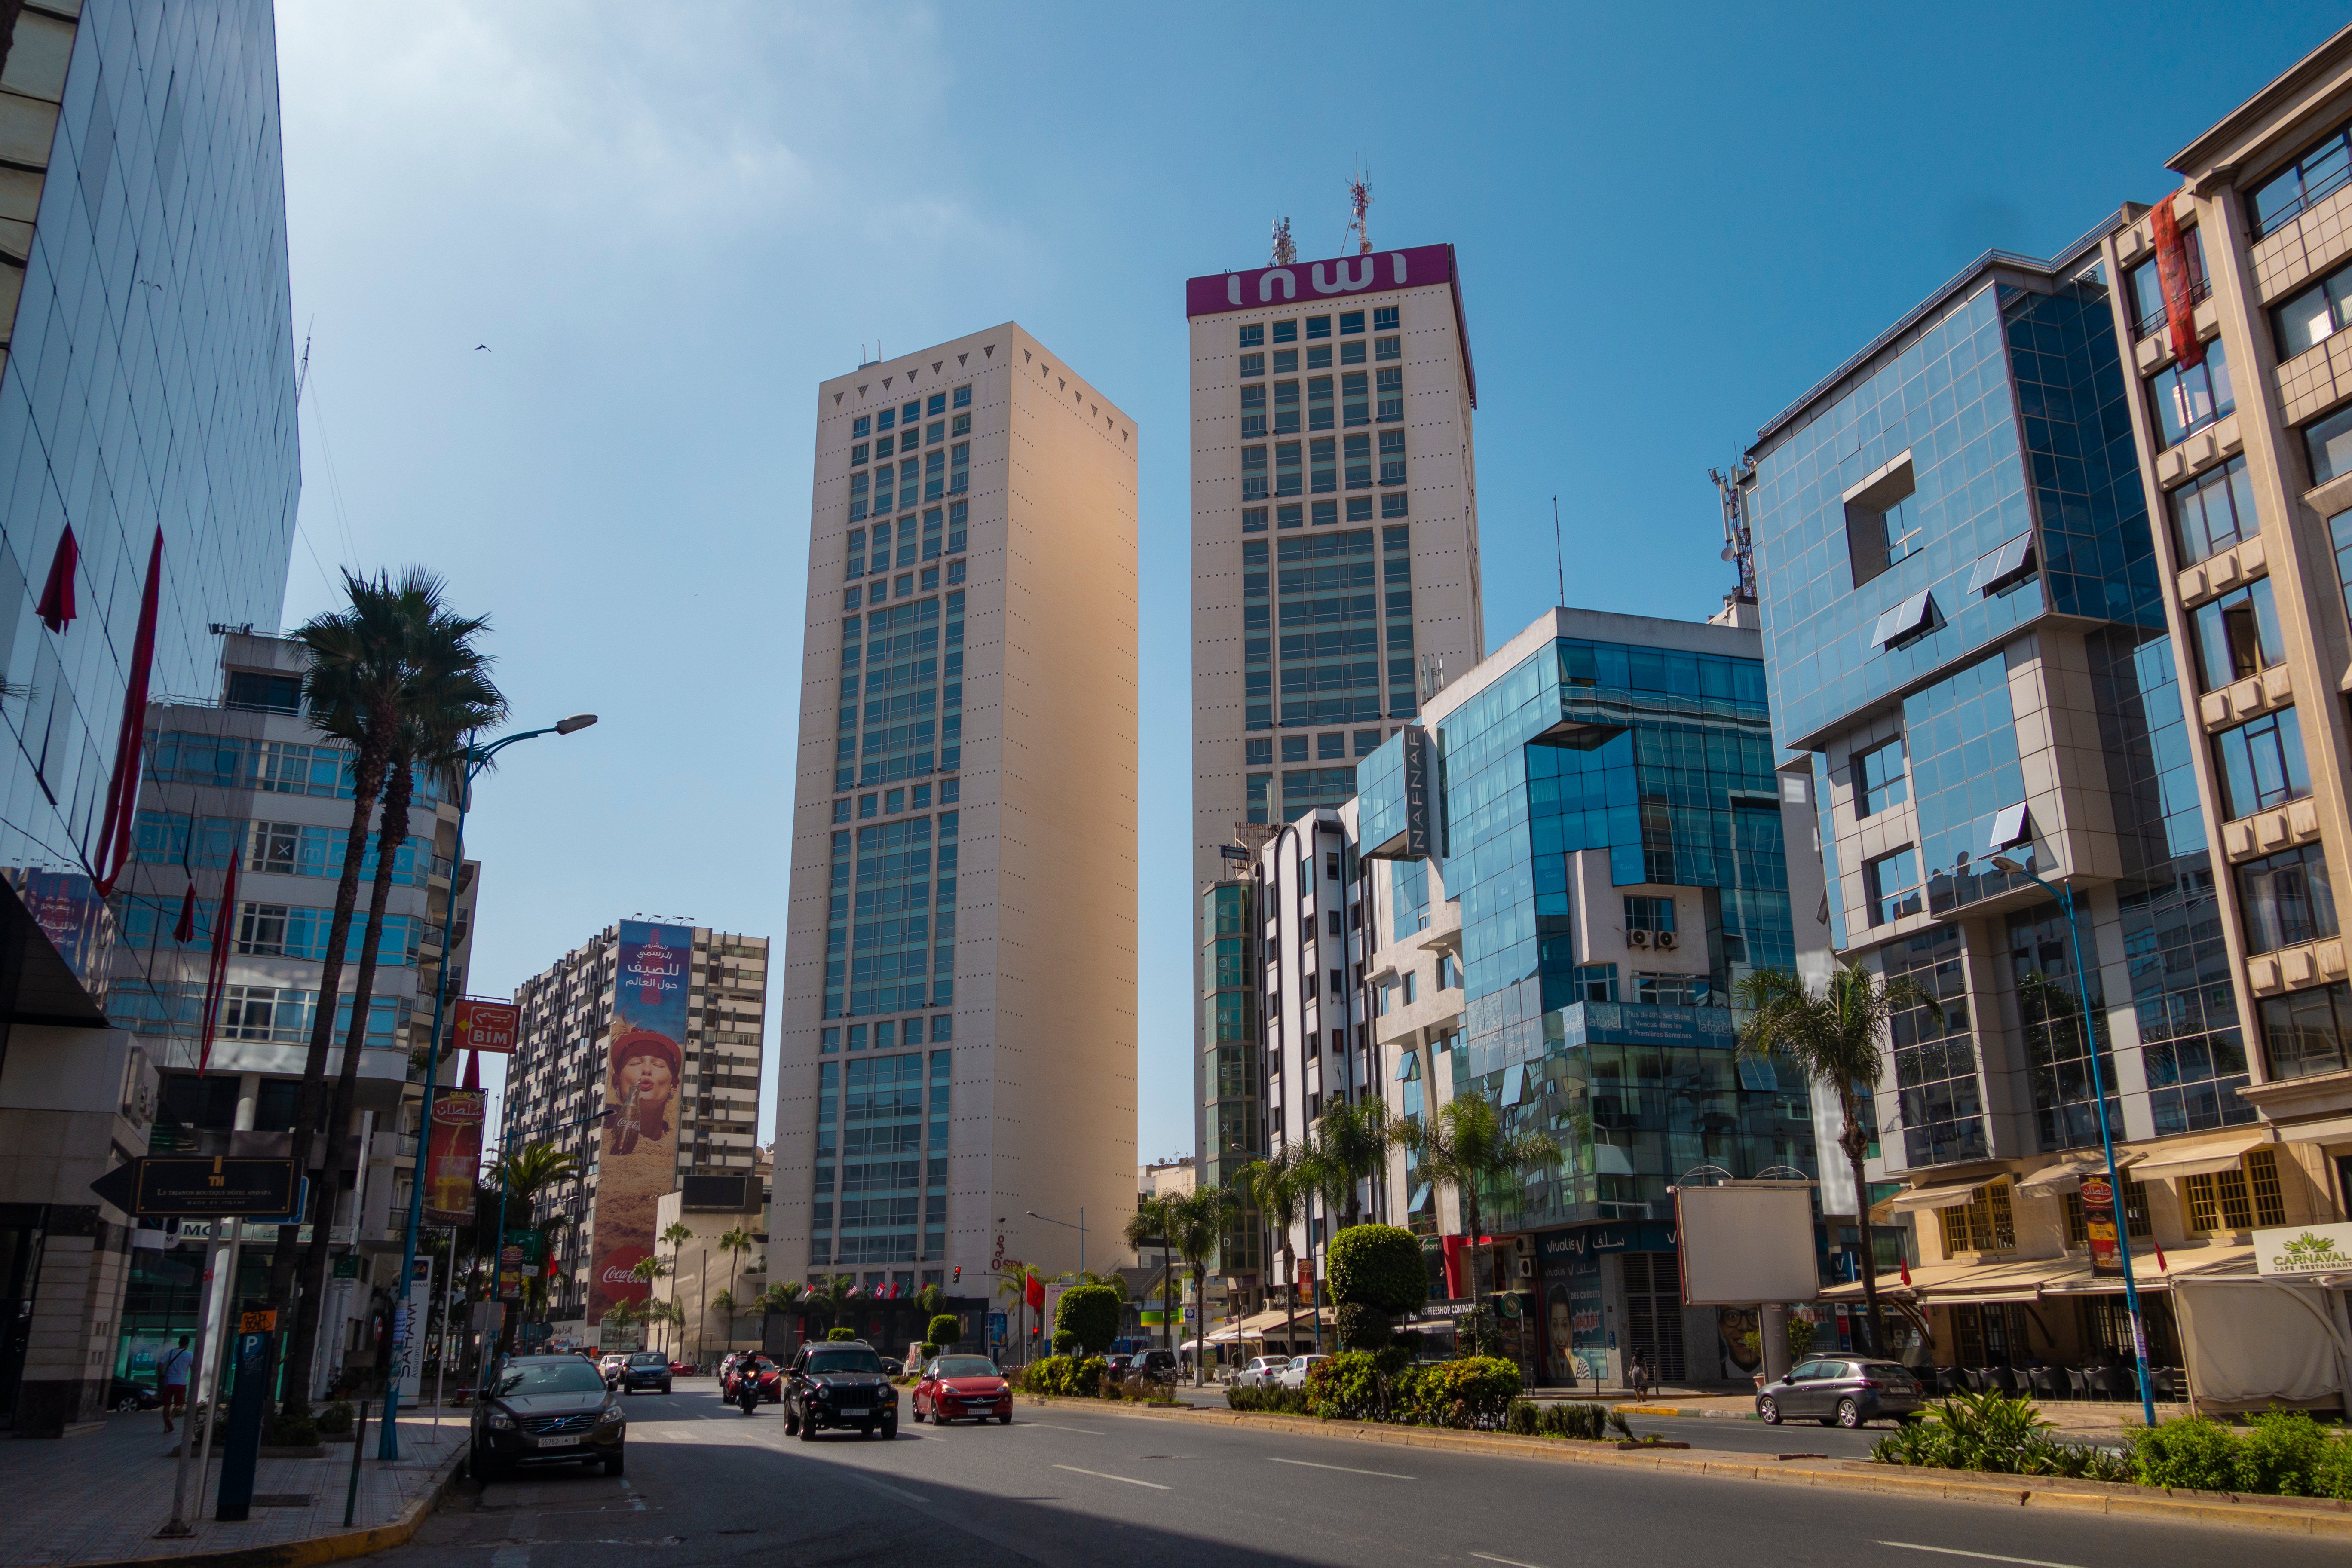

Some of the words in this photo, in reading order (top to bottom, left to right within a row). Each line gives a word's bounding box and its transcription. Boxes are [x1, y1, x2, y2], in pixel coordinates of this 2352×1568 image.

[1228, 253, 1407, 305] inwi
[1409, 732, 1424, 848] NAFNAF
[637, 951, 672, 960] الرسمي
[627, 961, 679, 976] للصيف
[625, 977, 655, 987] العالم
[657, 979, 677, 990] حول
[475, 1012, 511, 1025] بيم
[436, 1103, 481, 1116] سلطان
[2083, 1186, 2111, 1195] سلطان
[181, 1224, 223, 1236] MCI
[1592, 1231, 1625, 1249] سلف
[2272, 1251, 2352, 1266] CARNAVAL
[1576, 1263, 1596, 1274] سلف
[2300, 1262, 2352, 1270] RESTAURANT
[1571, 1291, 1579, 1300] DES
[1421, 1305, 1450, 1316] COFFEESHOP
[1452, 1303, 1476, 1314] COMPANY
[245, 1336, 257, 1353] P
[401, 1303, 417, 1378] SAHAM
[411, 1340, 421, 1378] Assurance
